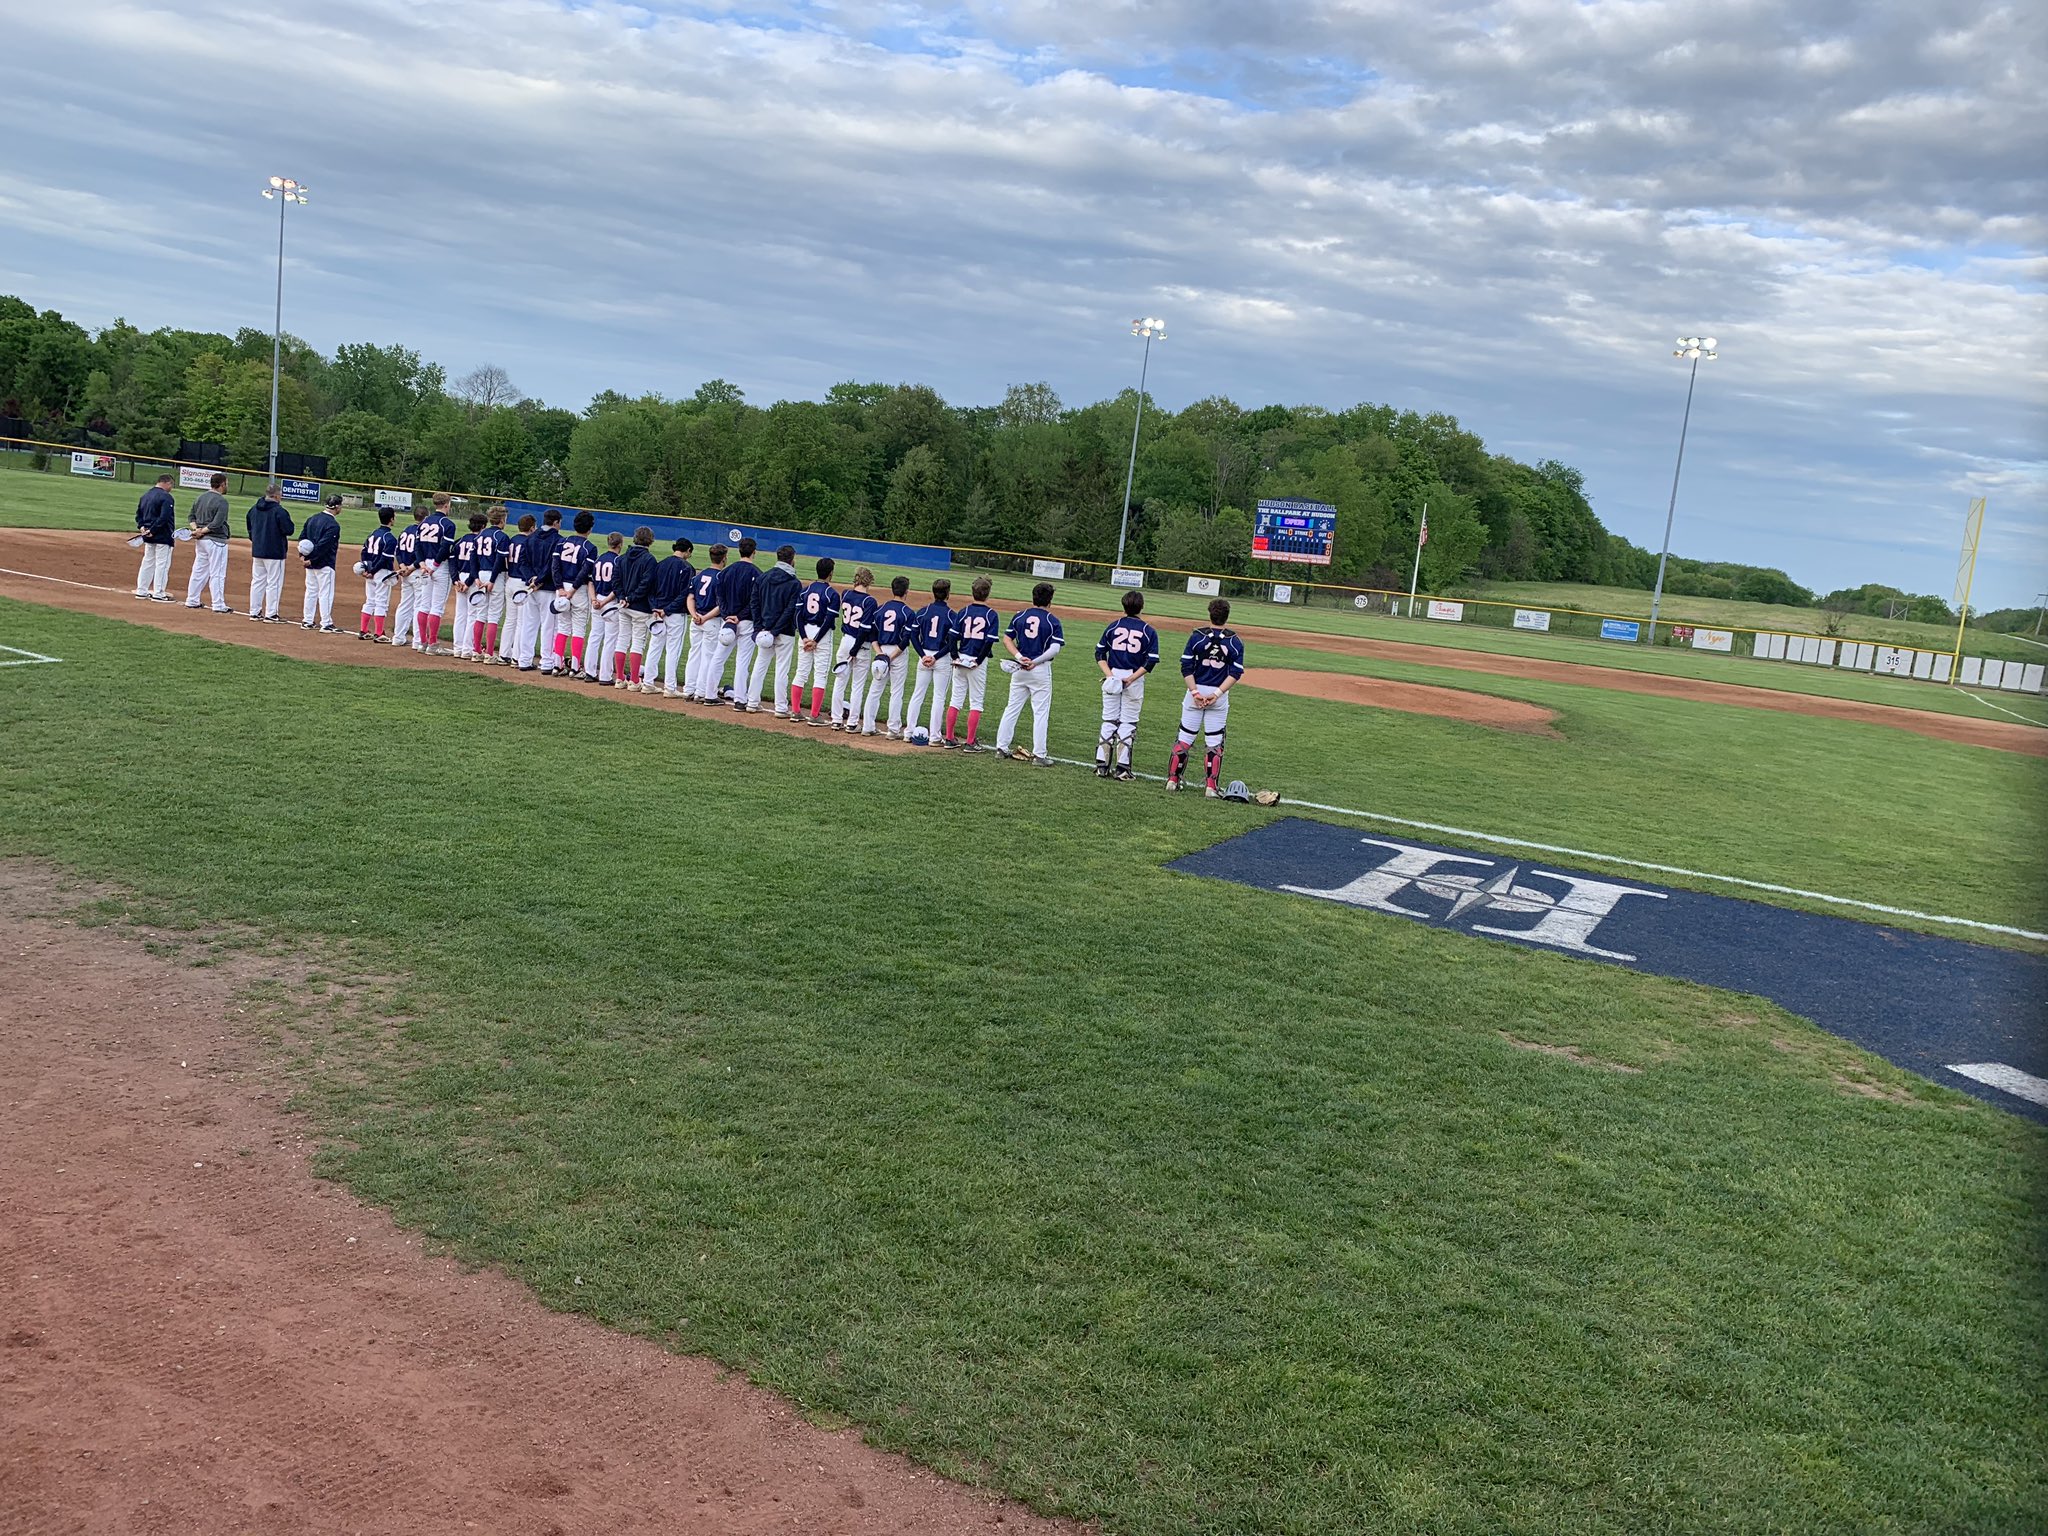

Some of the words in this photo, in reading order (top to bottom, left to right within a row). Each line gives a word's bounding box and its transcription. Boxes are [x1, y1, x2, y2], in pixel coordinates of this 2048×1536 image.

[282, 486, 318, 496] DENTISTRY
[1258, 500, 1292, 508] HUDSON
[1292, 502, 1337, 512] BASEBALL
[400, 532, 416, 552] 20
[419, 523, 440, 543] 22
[458, 541, 474, 560] 17
[476, 536, 492, 556] 13
[508, 542, 522, 564] 11
[560, 542, 582, 564] 21
[594, 561, 614, 583] 10
[698, 575, 712, 596] 7
[806, 592, 820, 614] 6
[1356, 597, 1366, 606] 375
[841, 602, 864, 628] 32
[884, 610, 898, 632] 2
[928, 615, 940, 638] 1
[963, 616, 986, 640] 12
[1024, 616, 1041, 639] 3
[1112, 627, 1144, 654] 25
[1886, 656, 1900, 666] 315
